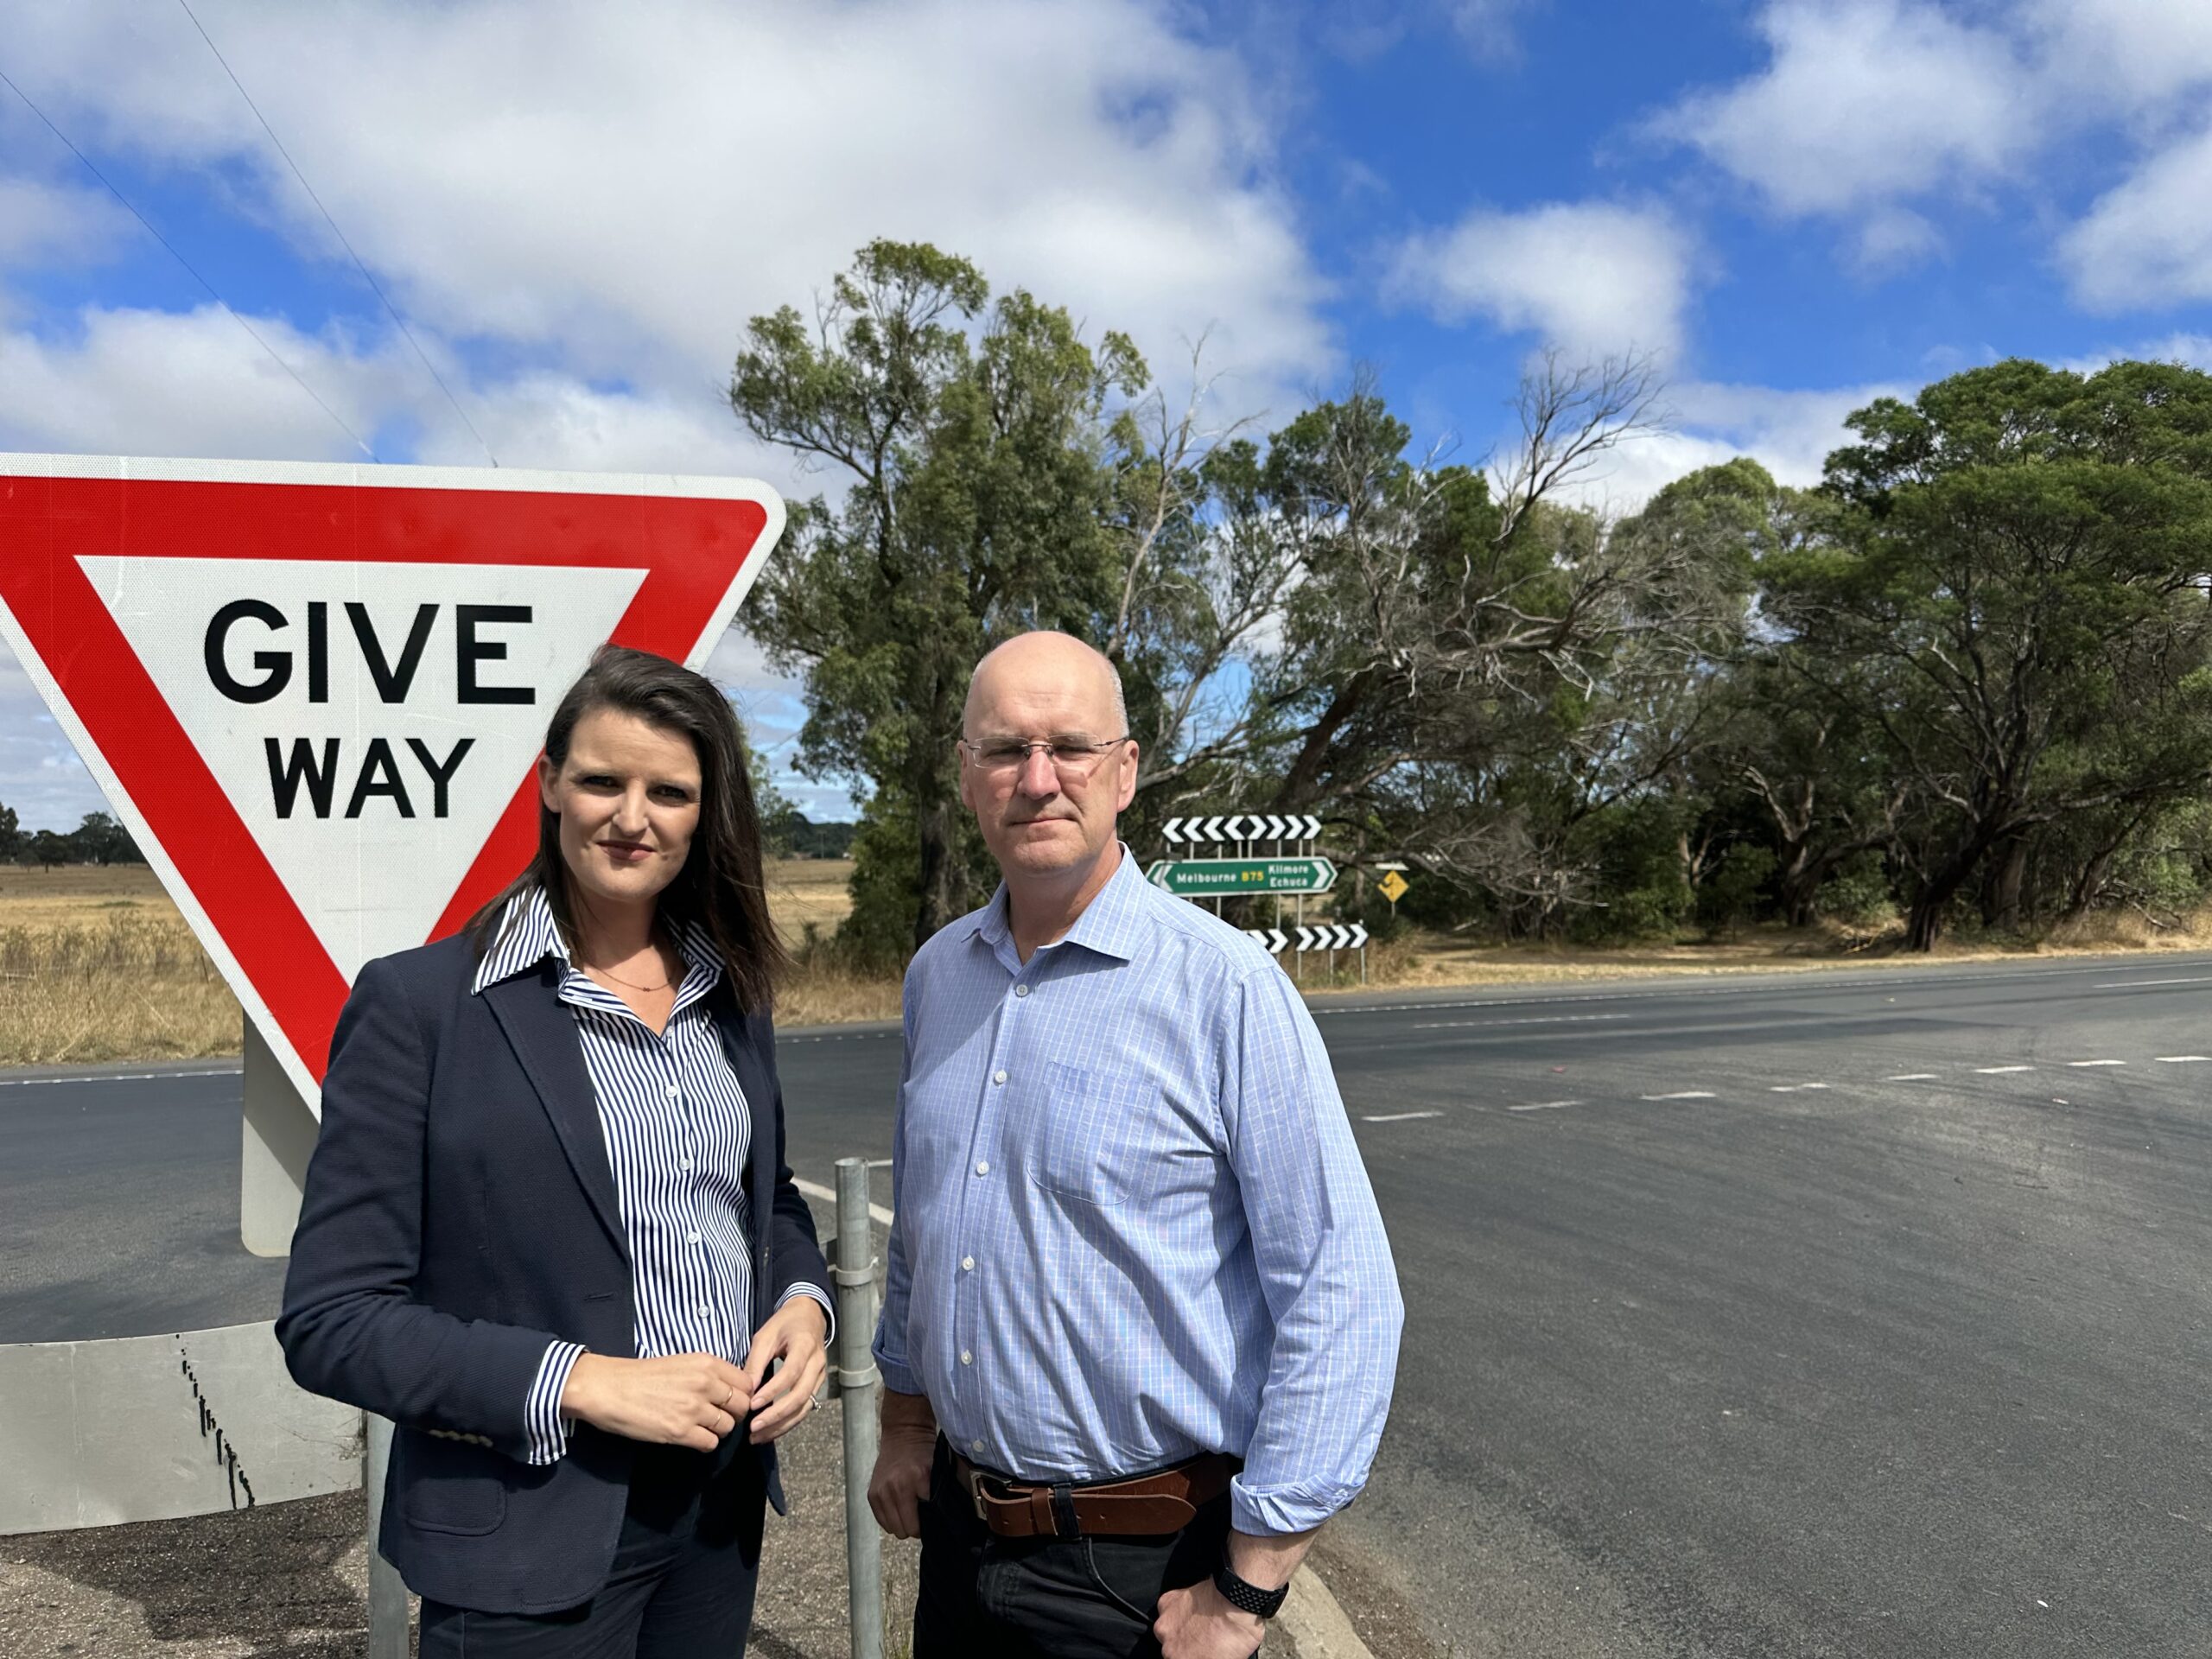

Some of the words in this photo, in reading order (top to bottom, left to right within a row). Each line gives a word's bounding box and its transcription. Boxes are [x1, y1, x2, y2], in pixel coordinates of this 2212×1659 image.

[205, 599, 536, 705] GIVE
[264, 737, 476, 819] WAY
[1268, 865, 1309, 874] Kilmore
[1176, 873, 1236, 883] Melbourne
[1241, 871, 1264, 881] B75
[1269, 877, 1308, 887] Echuca
